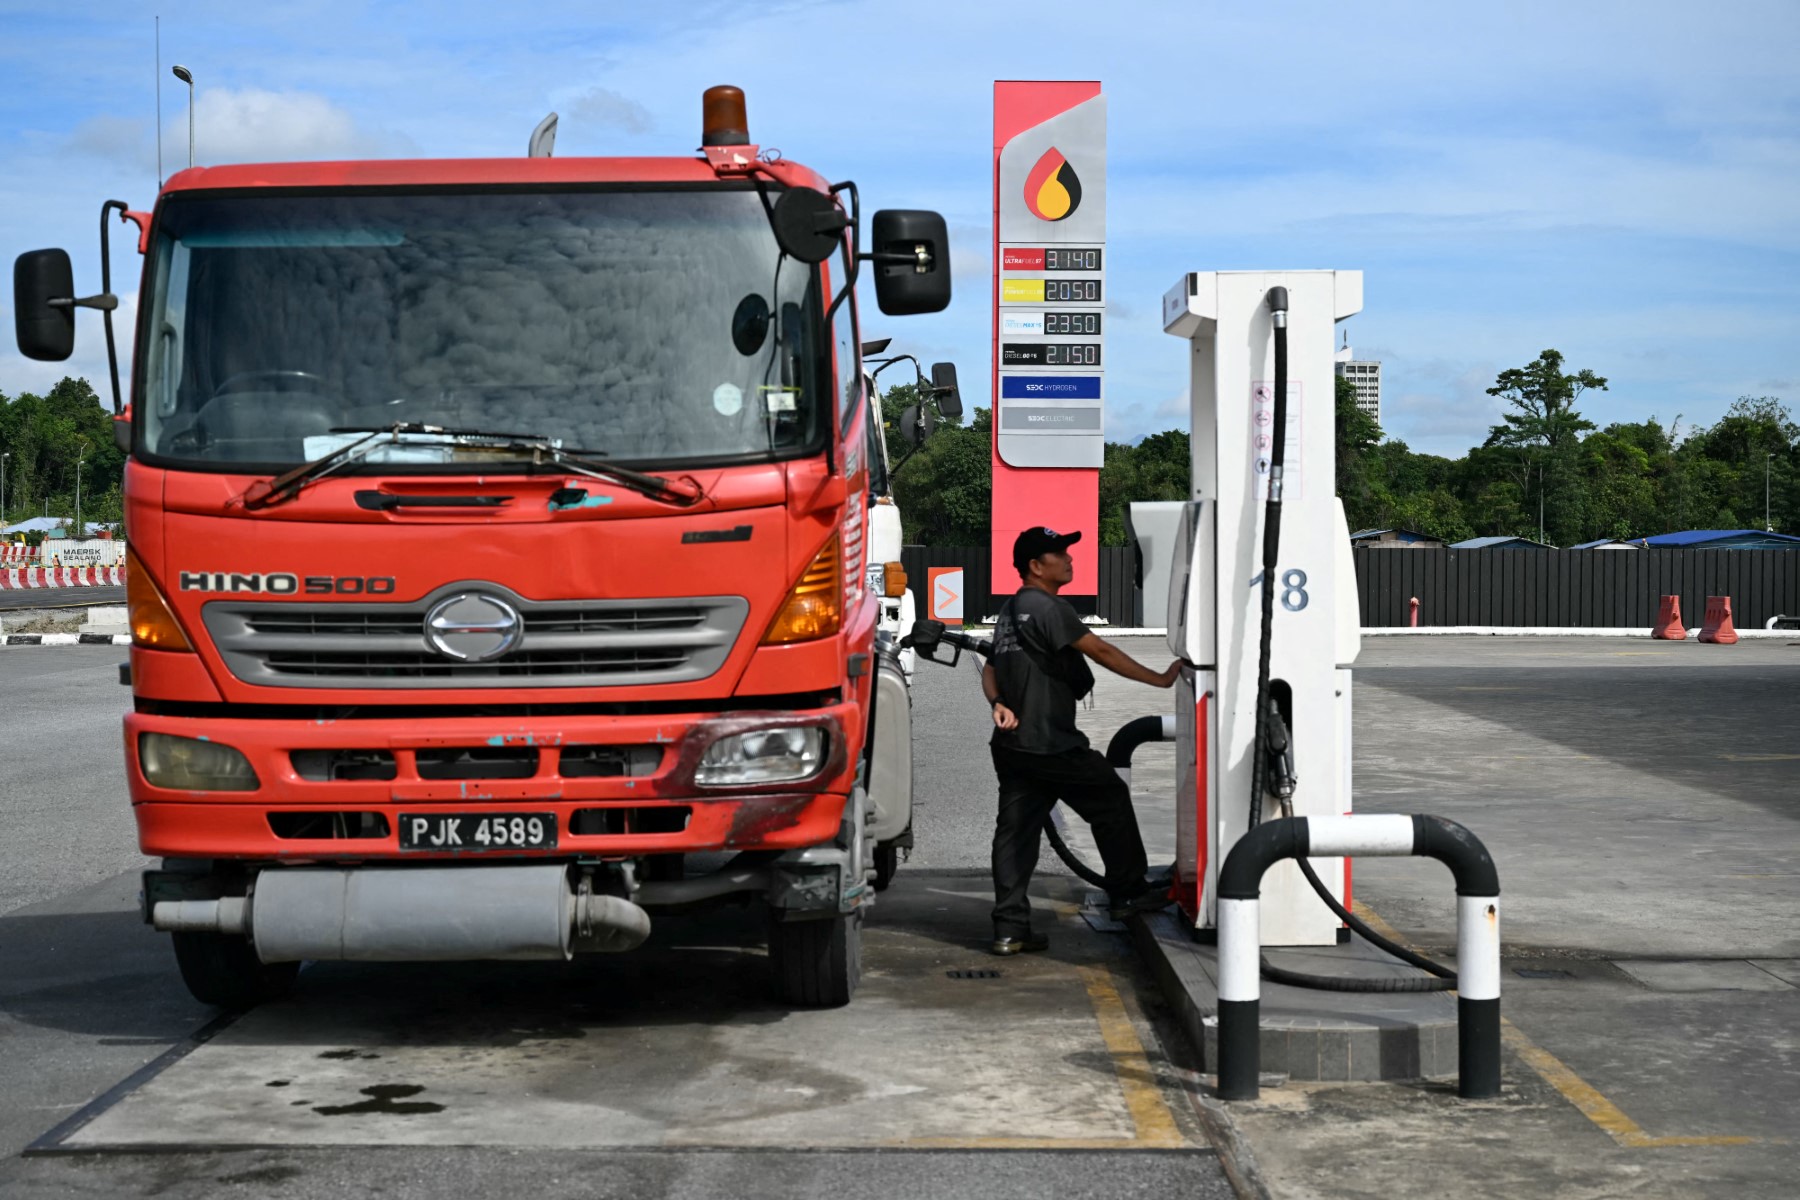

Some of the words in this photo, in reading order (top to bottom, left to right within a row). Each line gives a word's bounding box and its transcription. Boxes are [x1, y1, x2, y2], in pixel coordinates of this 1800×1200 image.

[1048, 251, 1096, 269] 3.140
[1047, 282, 1096, 300] 2.050
[1047, 315, 1096, 333] 2.350
[1046, 346, 1096, 364] 2.150
[180, 571, 298, 594] HINO
[304, 576, 395, 594] 500
[474, 817, 544, 846] 4589
